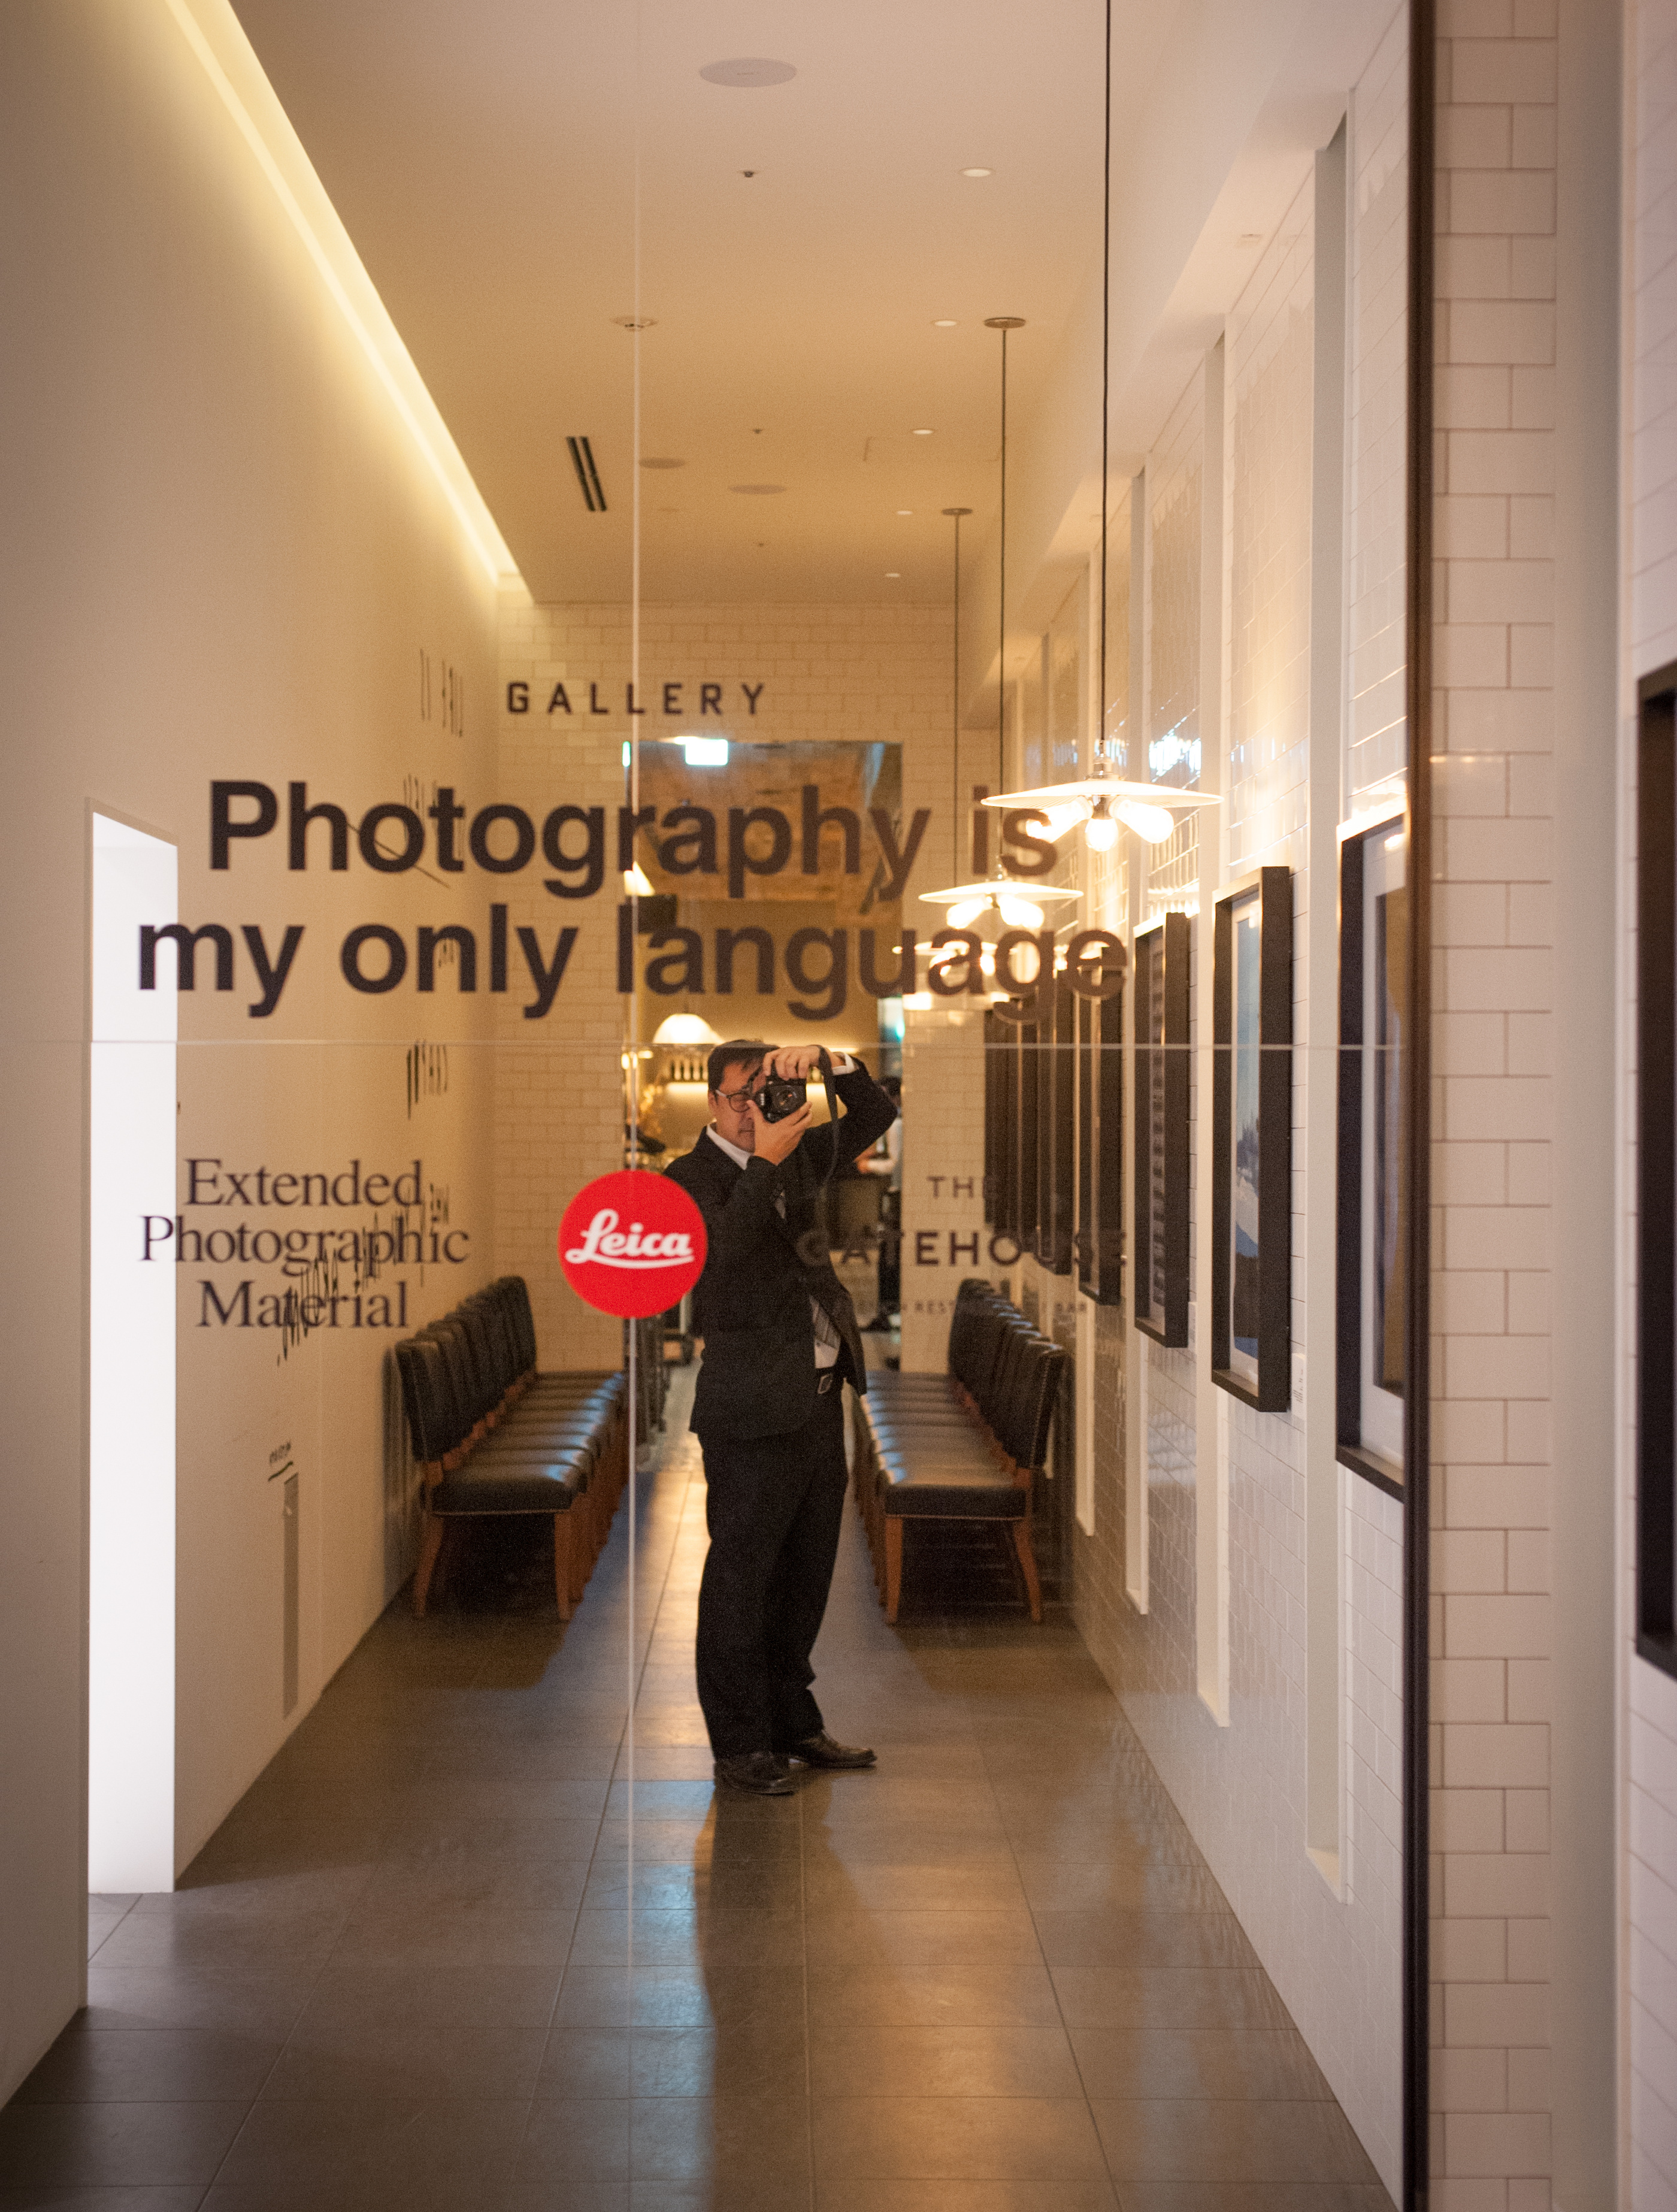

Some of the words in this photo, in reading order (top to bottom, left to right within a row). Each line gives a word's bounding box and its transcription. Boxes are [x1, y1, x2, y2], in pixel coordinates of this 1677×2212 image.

[507, 682, 765, 715] GALLERY
[209, 779, 932, 902] Photography
[972, 785, 1059, 876] is
[138, 923, 305, 1018] my
[340, 903, 580, 1019] only
[617, 903, 1128, 1022] language
[183, 1158, 423, 1207] Extended
[137, 1214, 472, 1279] Photographic
[565, 1208, 695, 1269] Leica
[194, 1280, 412, 1329] Material
